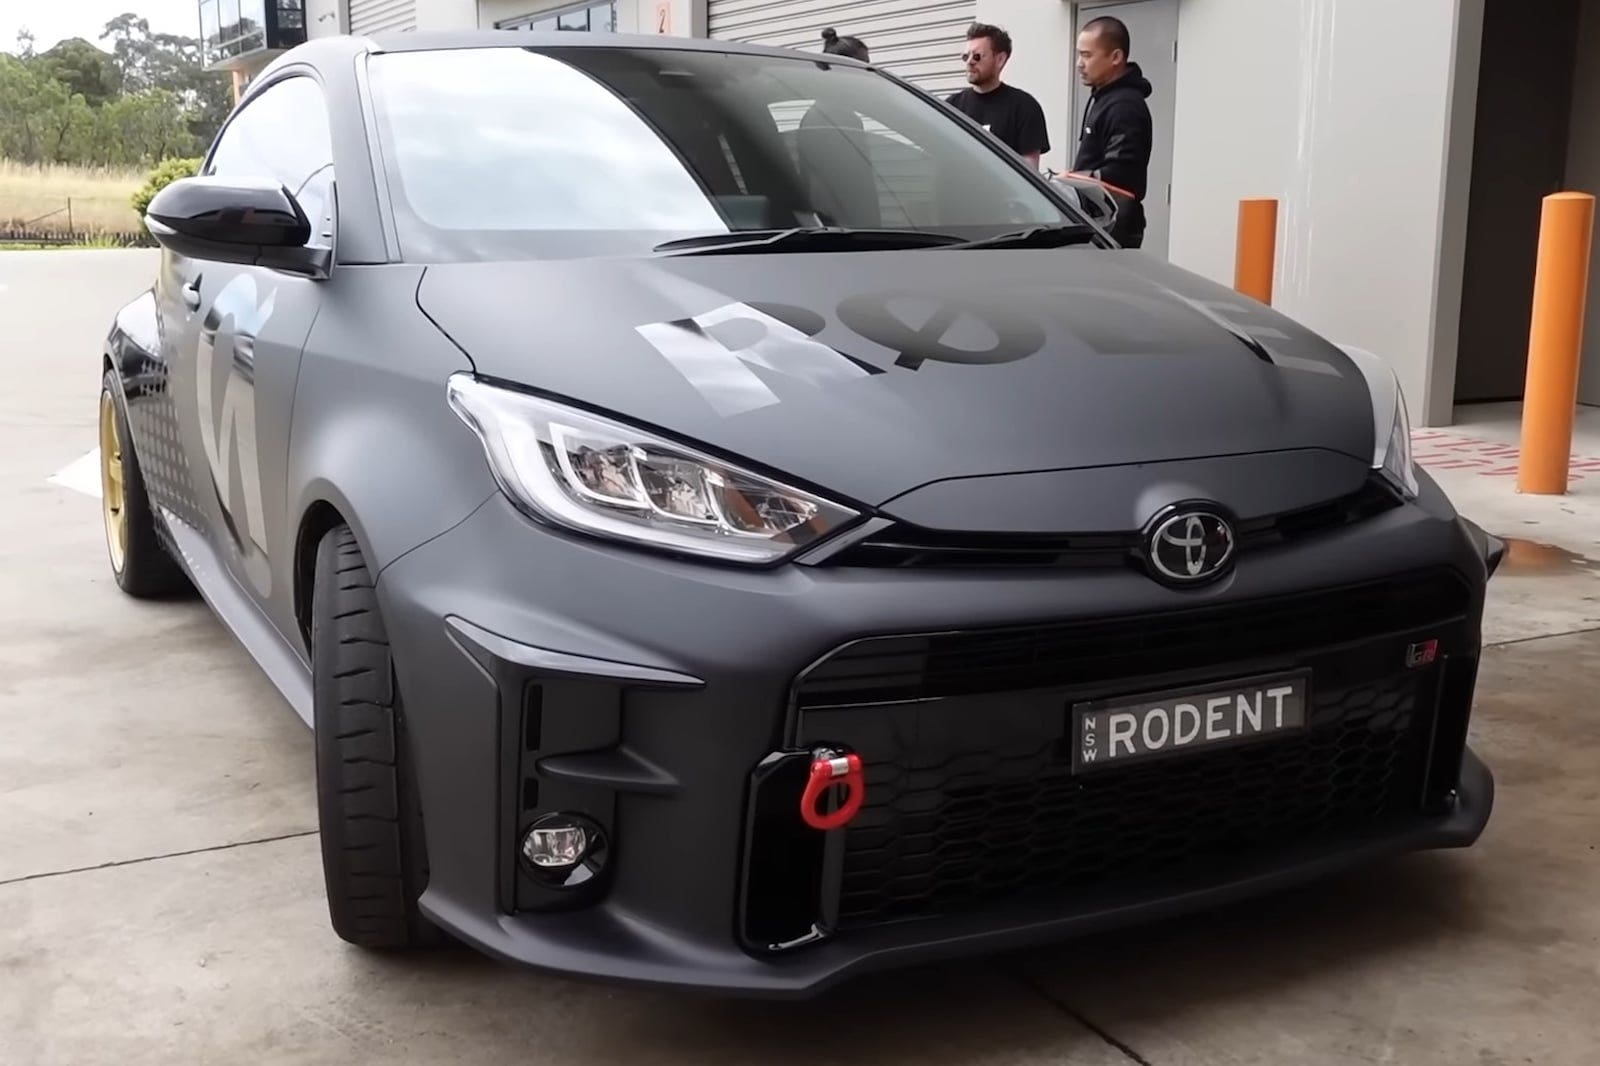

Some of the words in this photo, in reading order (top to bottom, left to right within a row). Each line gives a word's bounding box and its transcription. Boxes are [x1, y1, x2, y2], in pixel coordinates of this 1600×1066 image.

[659, 9, 667, 33] 2
[1083, 717, 1097, 763] NSW
[1109, 686, 1293, 757] RODENT
